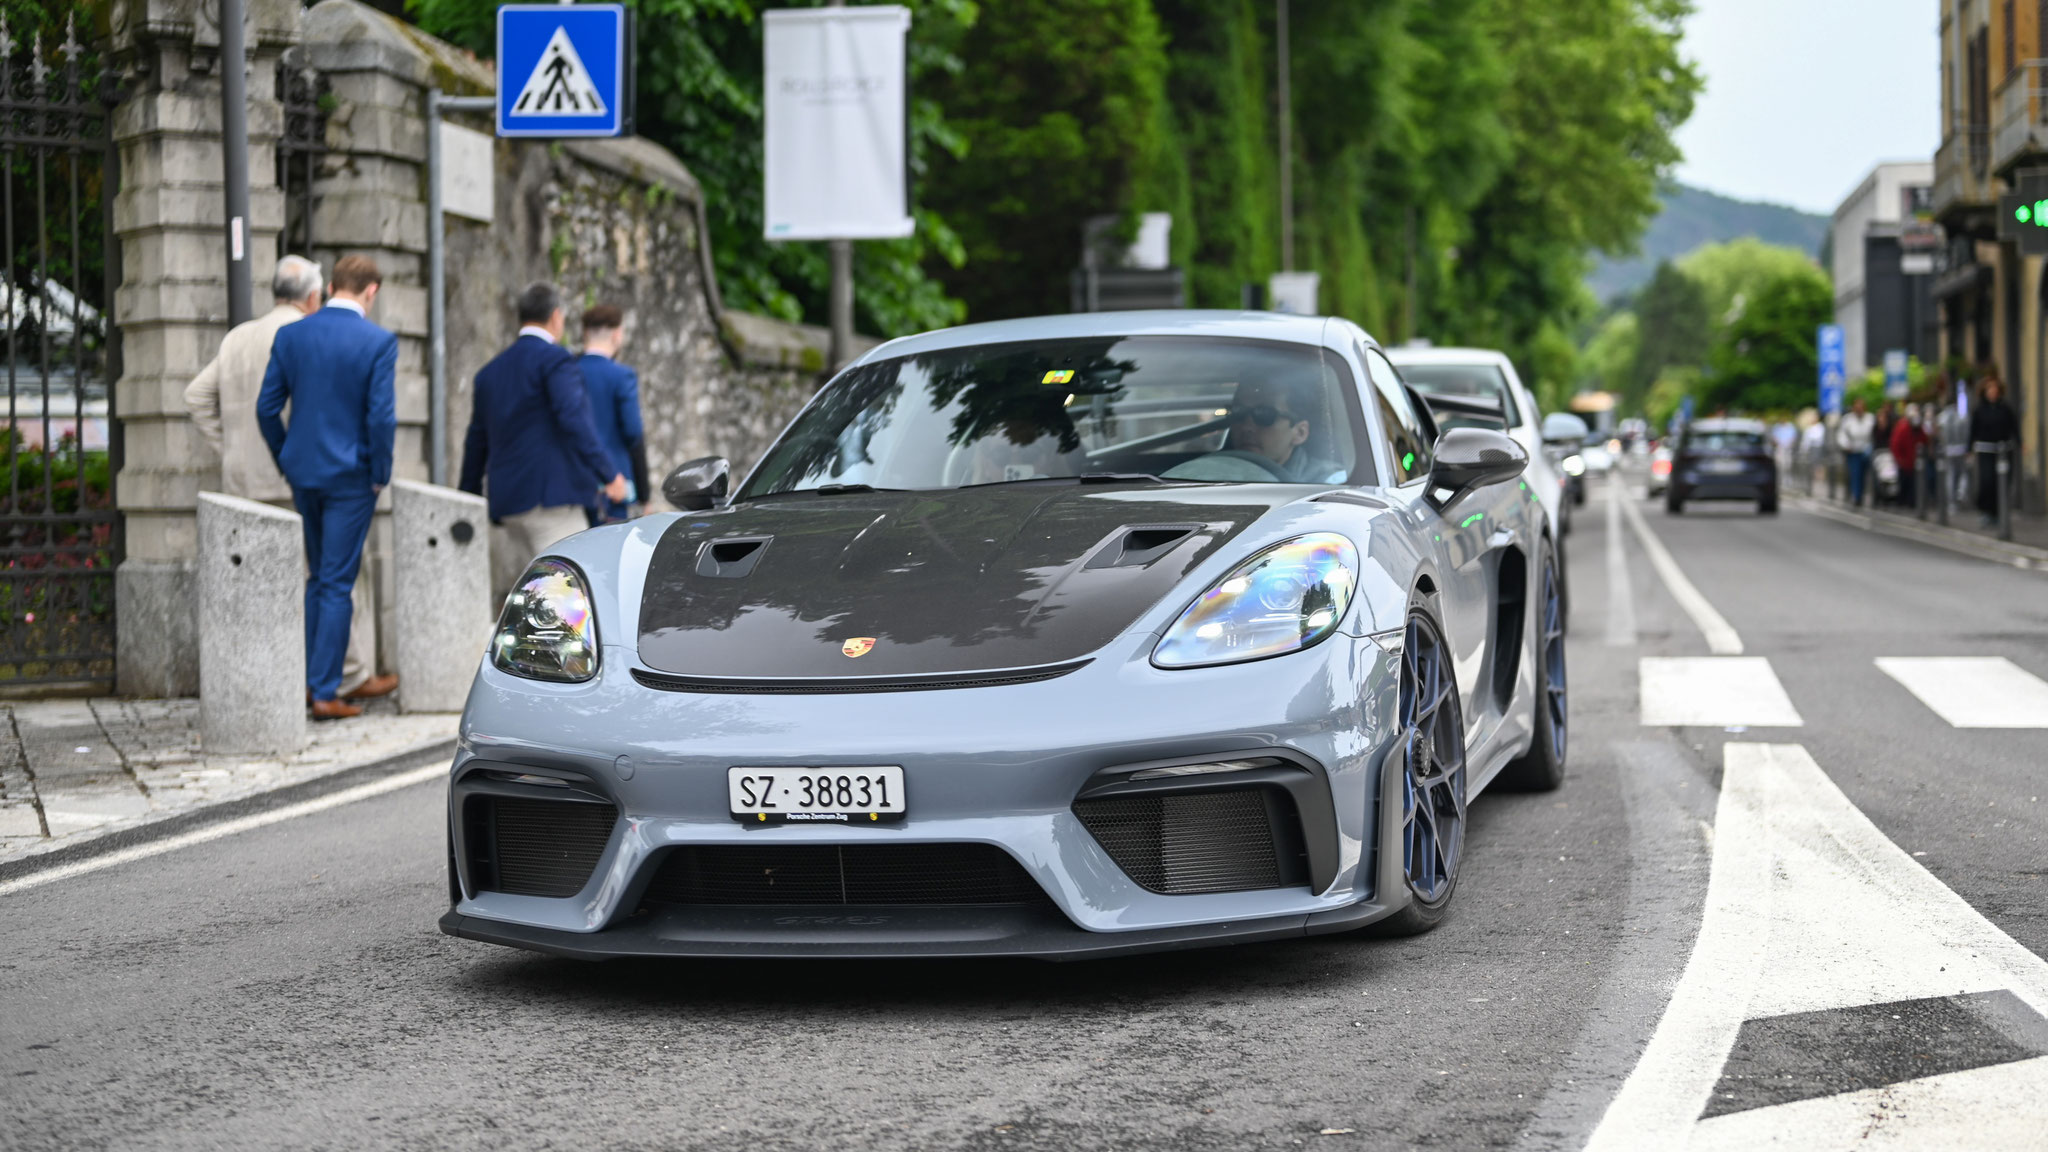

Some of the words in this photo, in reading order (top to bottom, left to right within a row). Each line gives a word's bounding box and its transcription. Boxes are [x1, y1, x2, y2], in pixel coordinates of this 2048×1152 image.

[740, 776, 776, 808] SZ
[798, 775, 891, 808] 38831
[786, 812, 810, 820] Porsche
